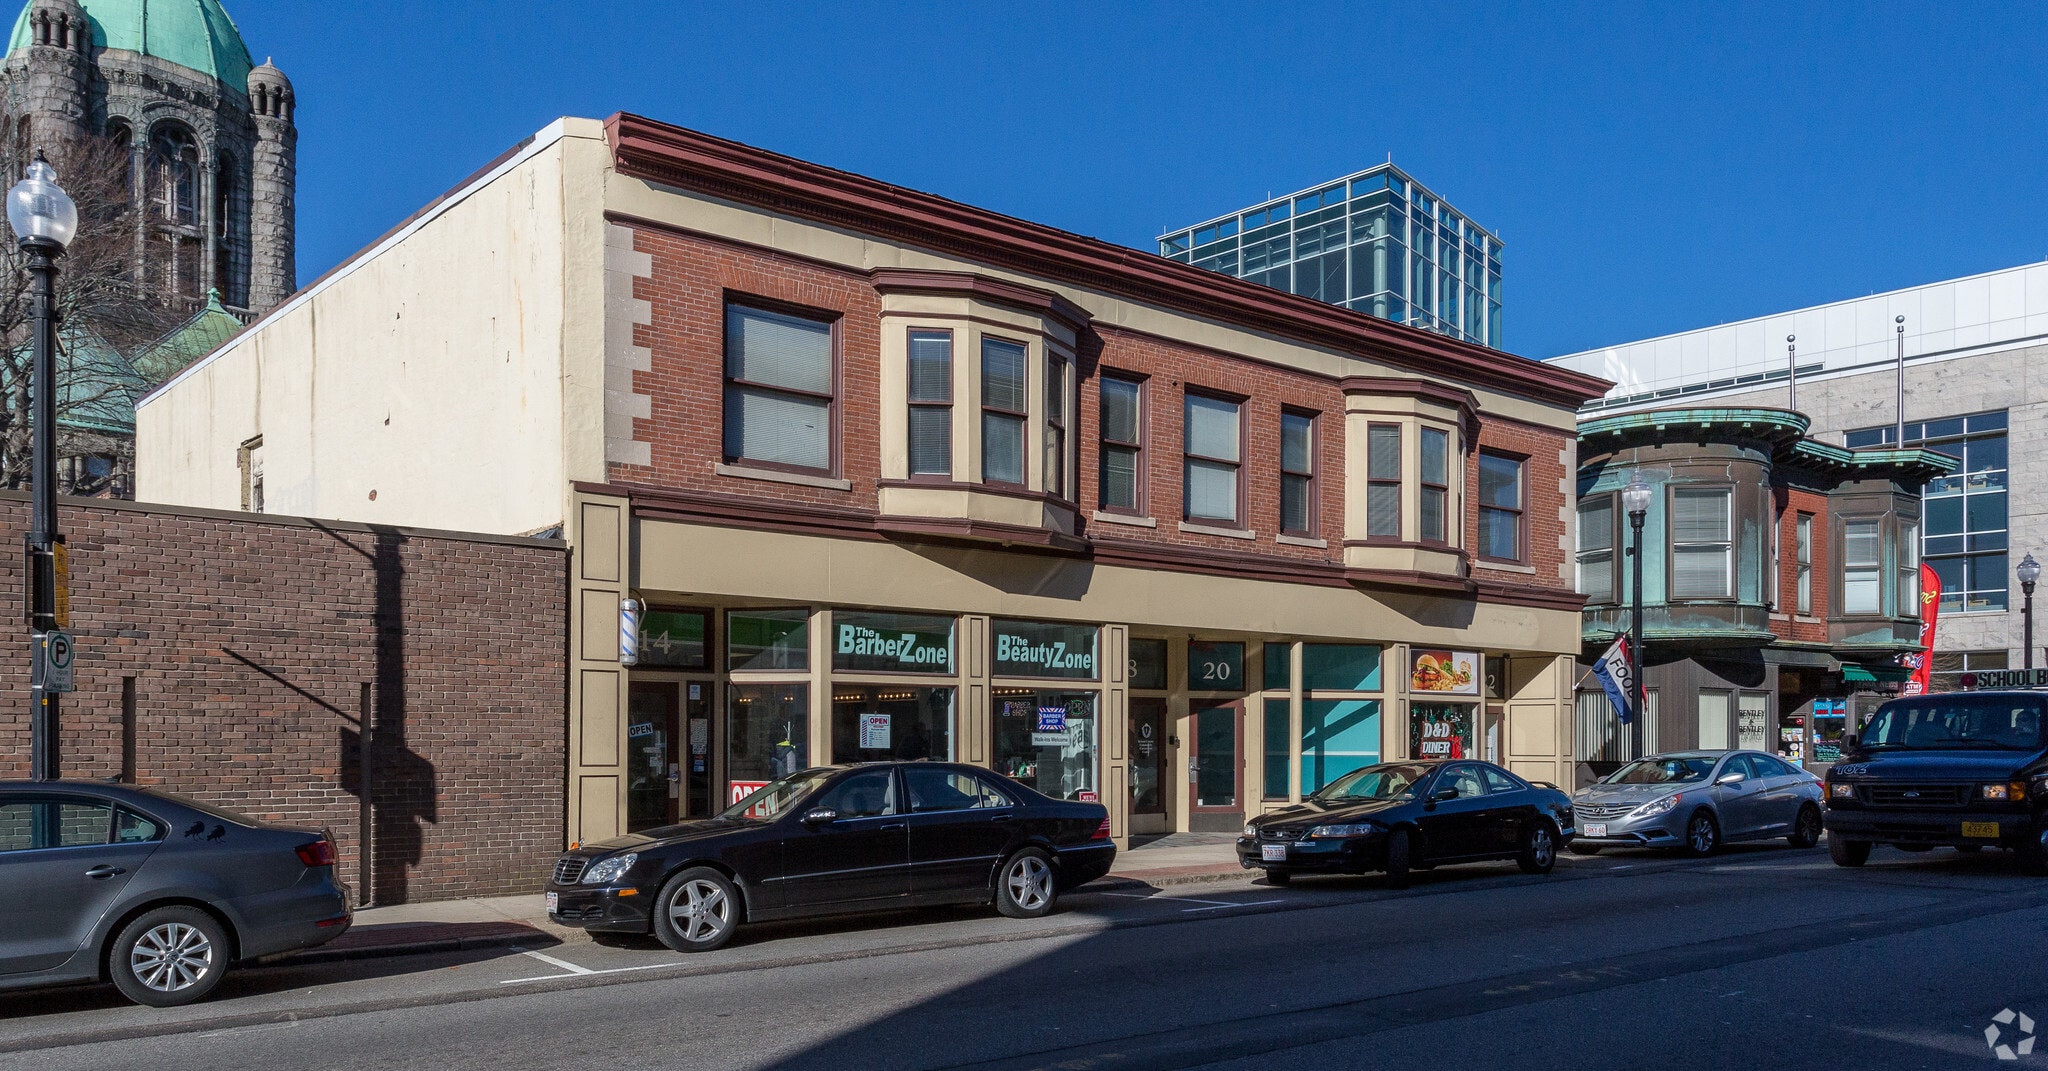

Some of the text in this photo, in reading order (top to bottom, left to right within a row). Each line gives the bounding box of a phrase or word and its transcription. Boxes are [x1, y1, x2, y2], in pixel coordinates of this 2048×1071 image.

[856, 627, 874, 637] The
[640, 629, 671, 655] 14
[1010, 636, 1028, 646] The
[55, 641, 67, 663] P
[1202, 662, 1230, 680] 20
[1978, 669, 2048, 687] SCHOOL B
[630, 724, 652, 736] OPEN
[1423, 722, 1450, 738] D&D
[1422, 741, 1450, 754] DINER
